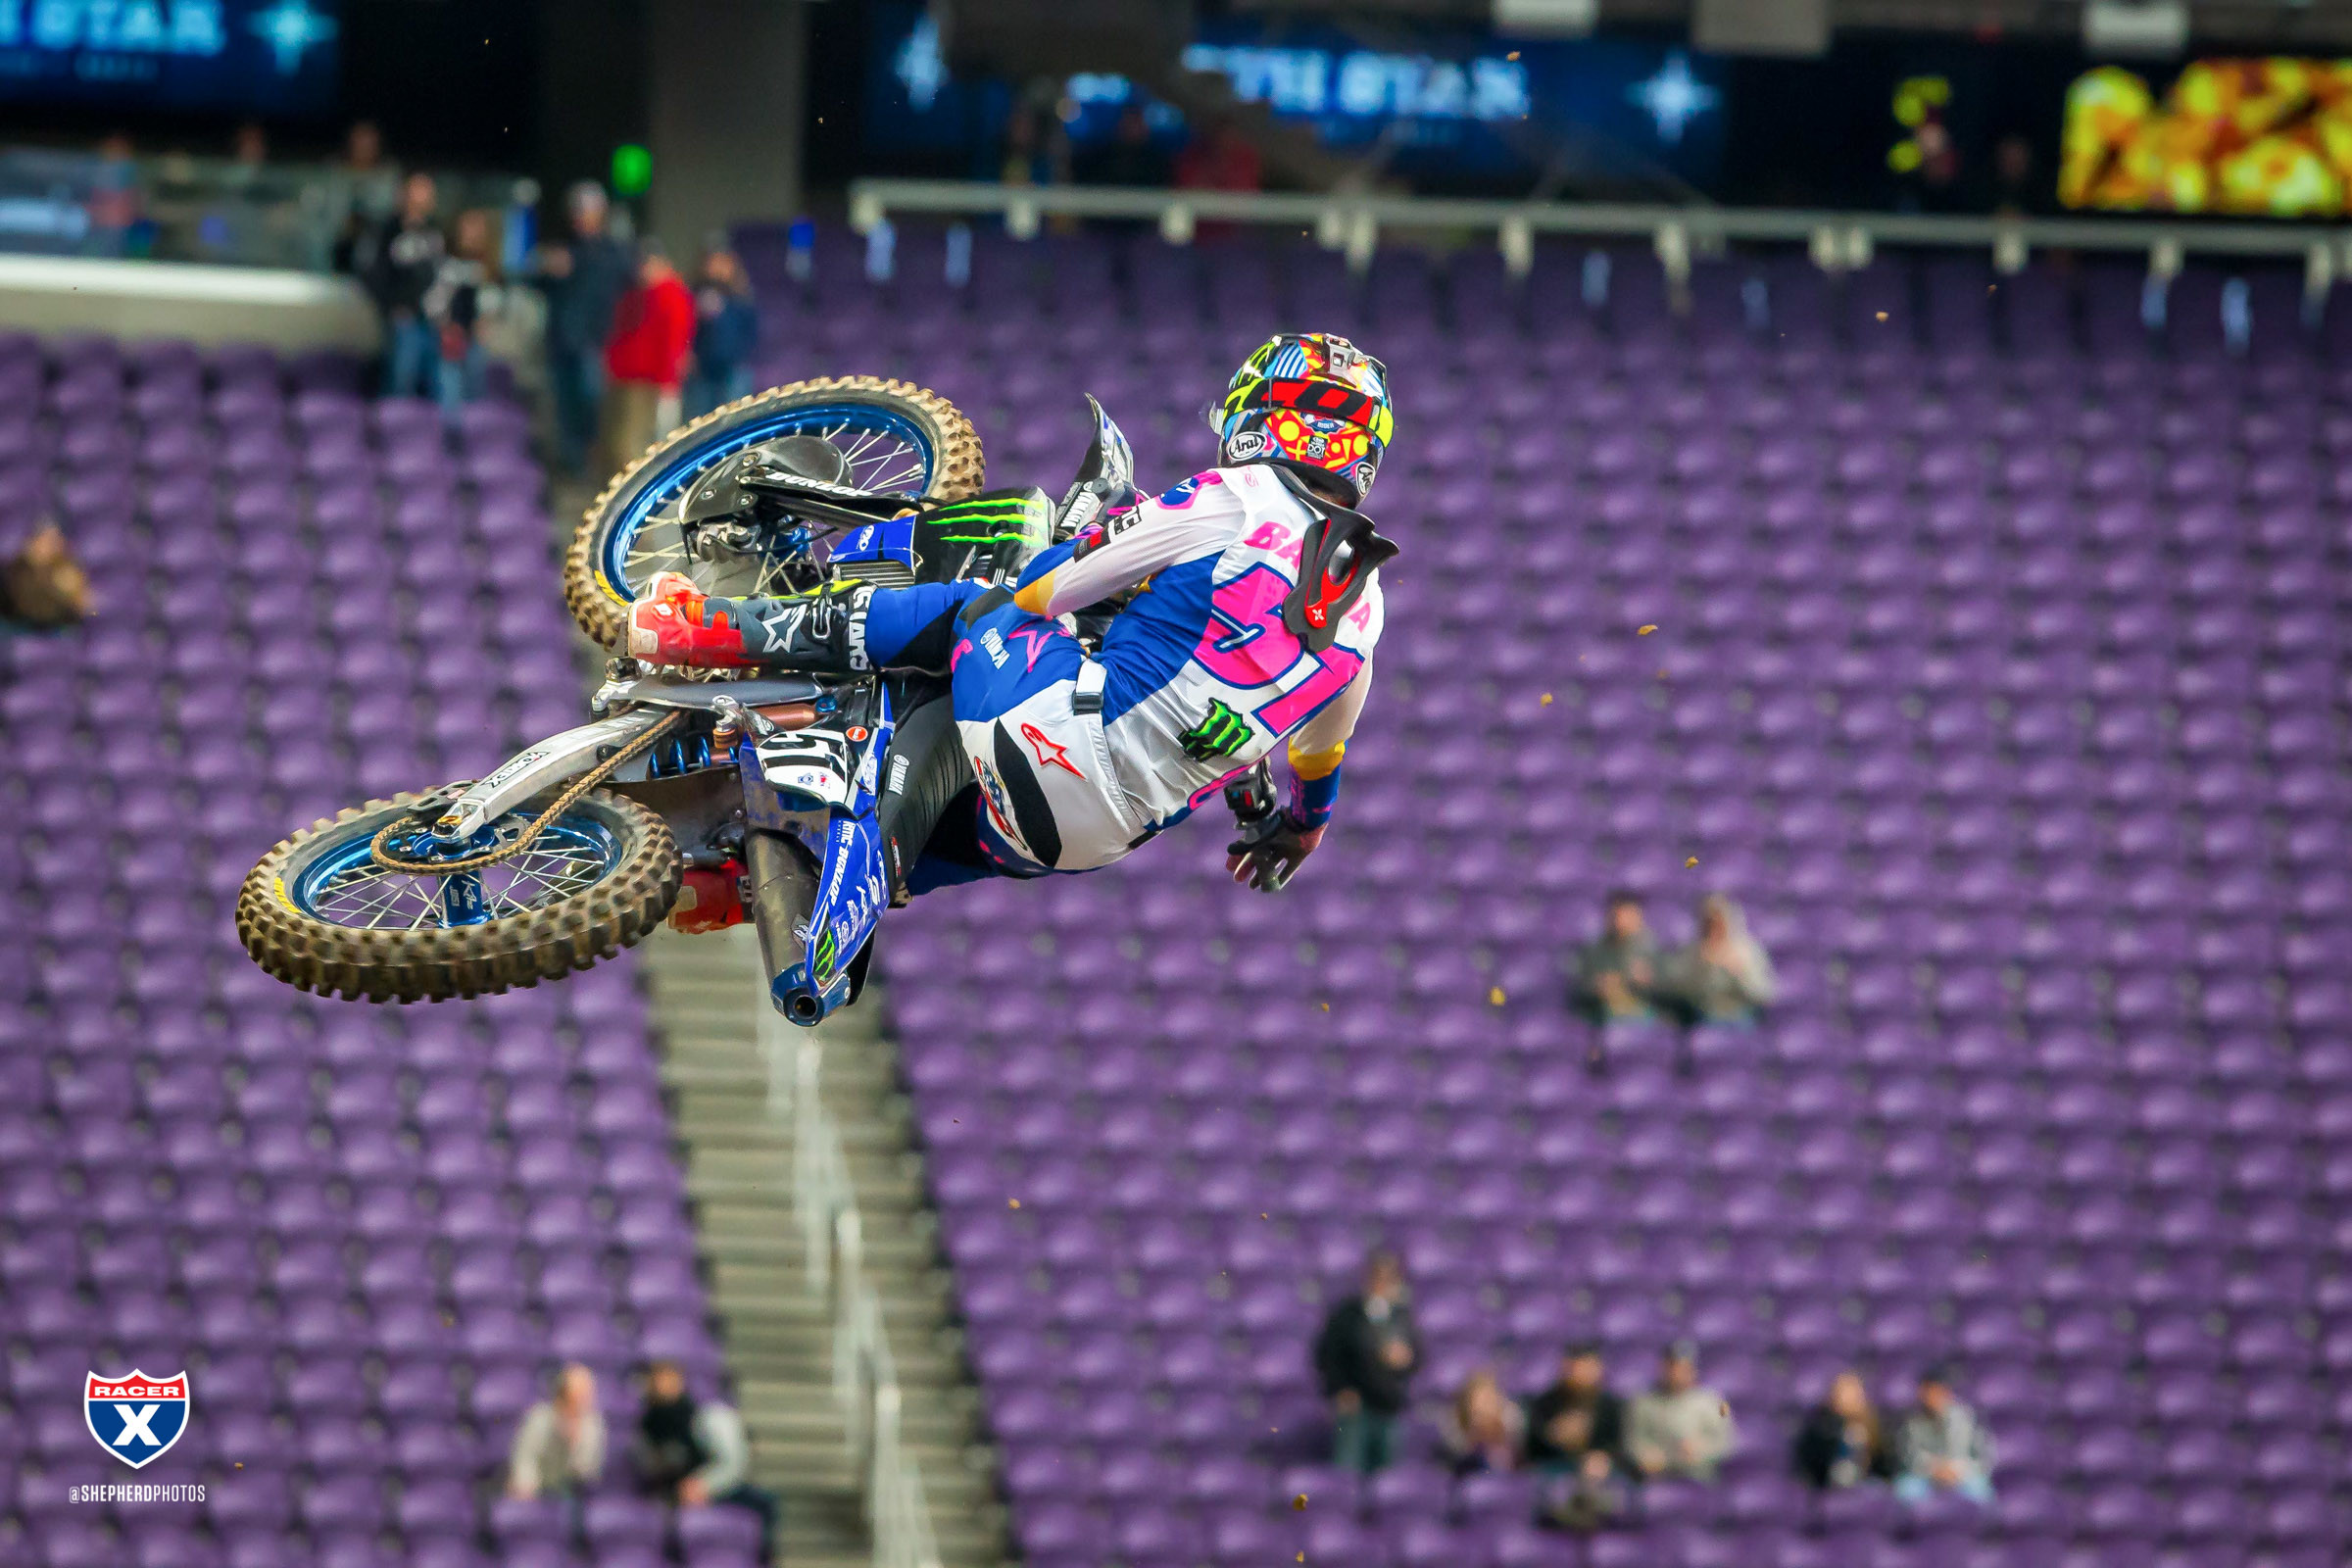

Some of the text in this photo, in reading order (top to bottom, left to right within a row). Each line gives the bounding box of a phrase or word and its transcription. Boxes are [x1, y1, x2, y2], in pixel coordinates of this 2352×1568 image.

[1231, 434, 1260, 455] Arai
[1307, 443, 1325, 455] DOT
[765, 471, 877, 498] DUNLOP
[830, 845, 850, 906] DUNLOP
